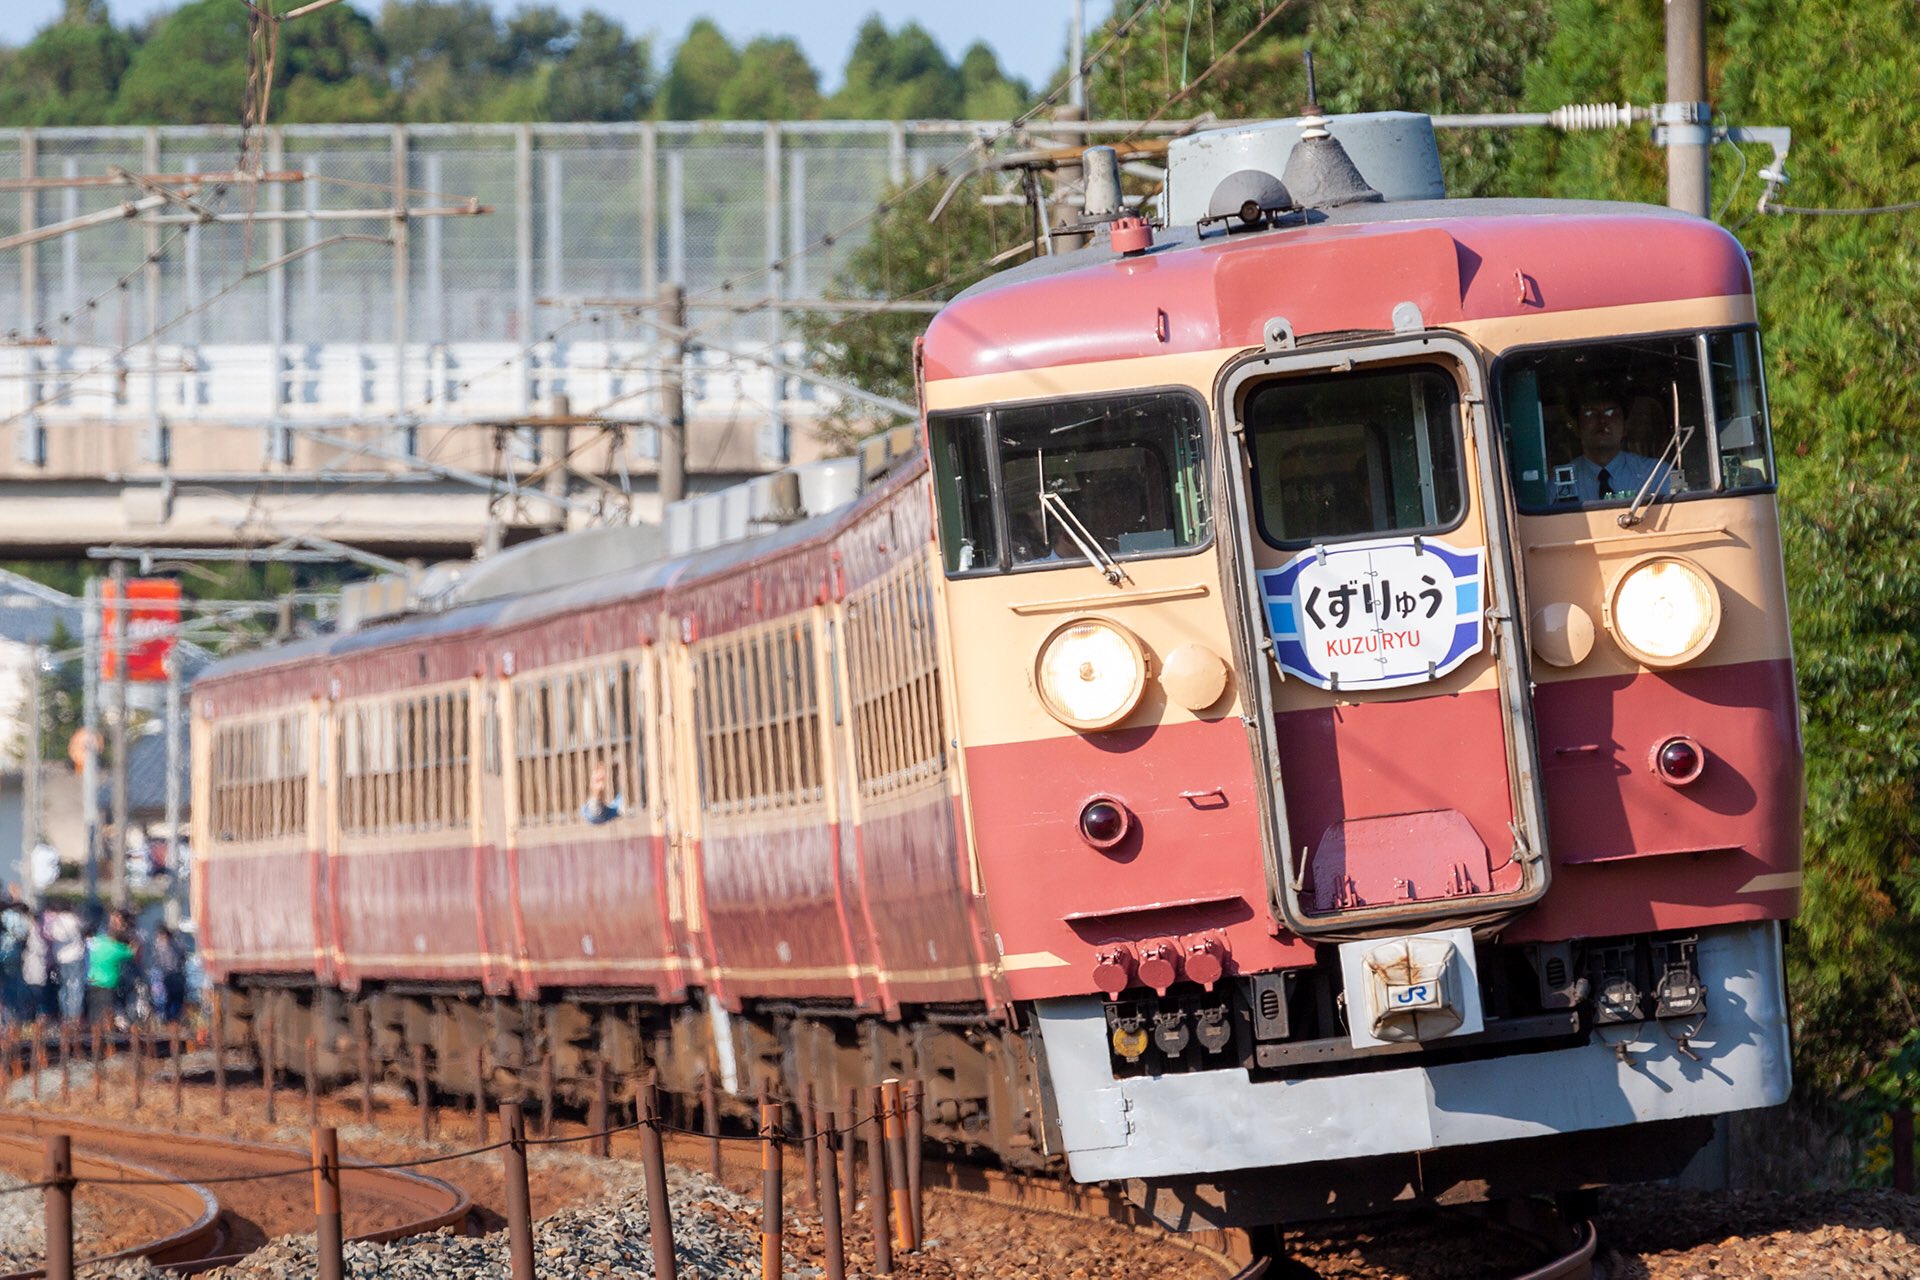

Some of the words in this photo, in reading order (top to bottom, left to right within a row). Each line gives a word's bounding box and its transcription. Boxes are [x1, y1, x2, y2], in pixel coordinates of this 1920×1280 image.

[1305, 575, 1443, 630] くずりゅう
[1326, 630, 1421, 657] KUZURYU
[1398, 986, 1427, 1003] JR
